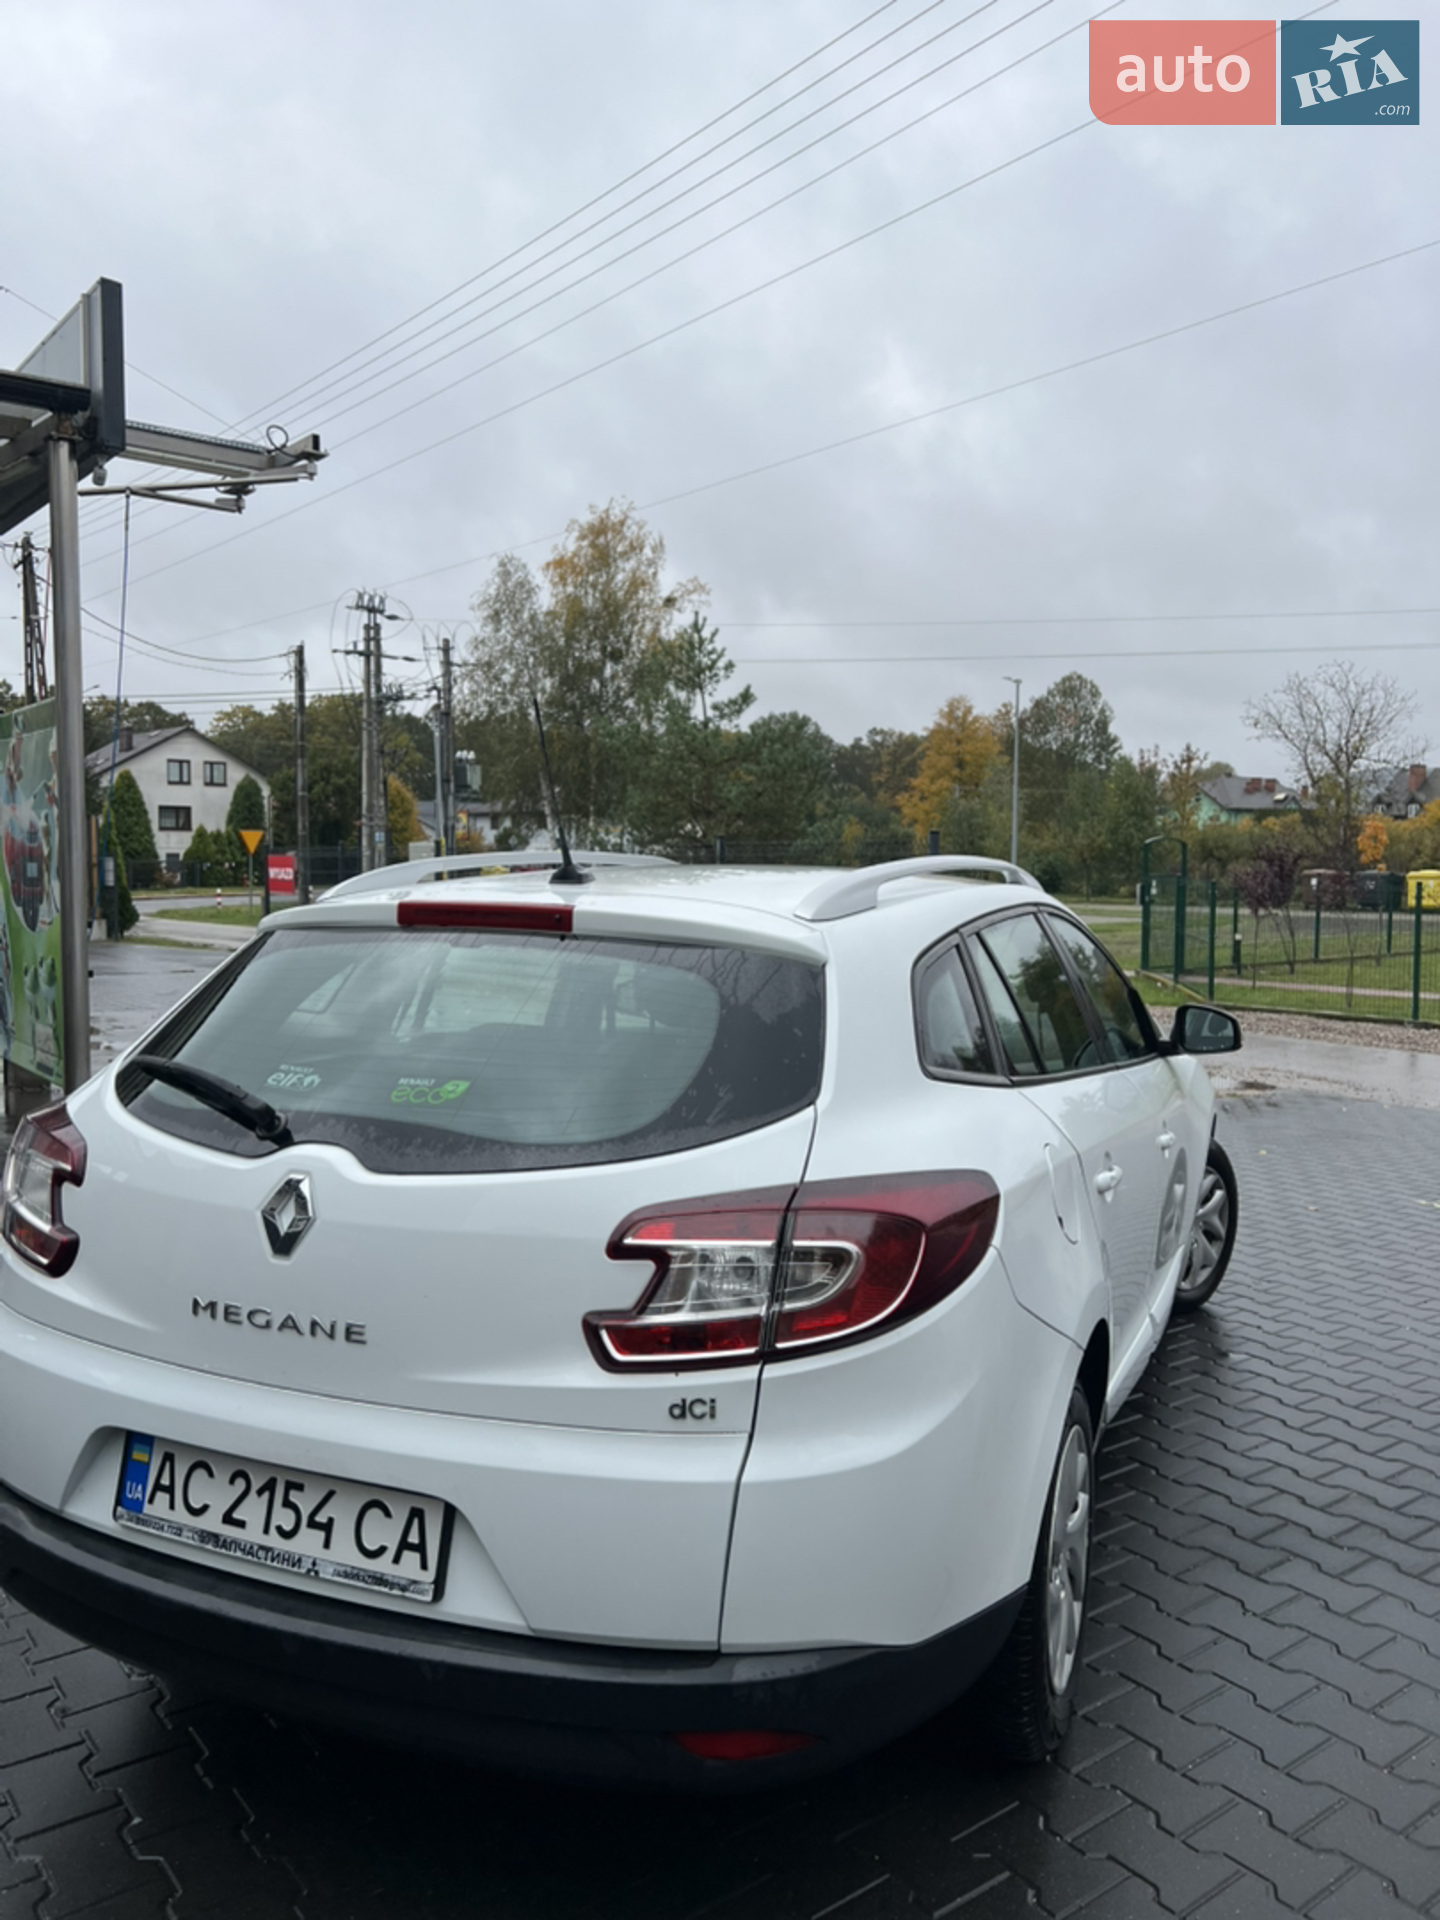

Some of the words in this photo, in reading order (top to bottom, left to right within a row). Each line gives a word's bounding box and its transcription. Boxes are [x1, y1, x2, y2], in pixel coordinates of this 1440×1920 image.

[191, 1295, 368, 1346] MEGANE
[668, 1397, 717, 1420] dCi
[125, 1479, 144, 1502] UA
[147, 1450, 216, 1518] AC
[221, 1468, 337, 1551] 2154
[354, 1498, 430, 1572] CA
